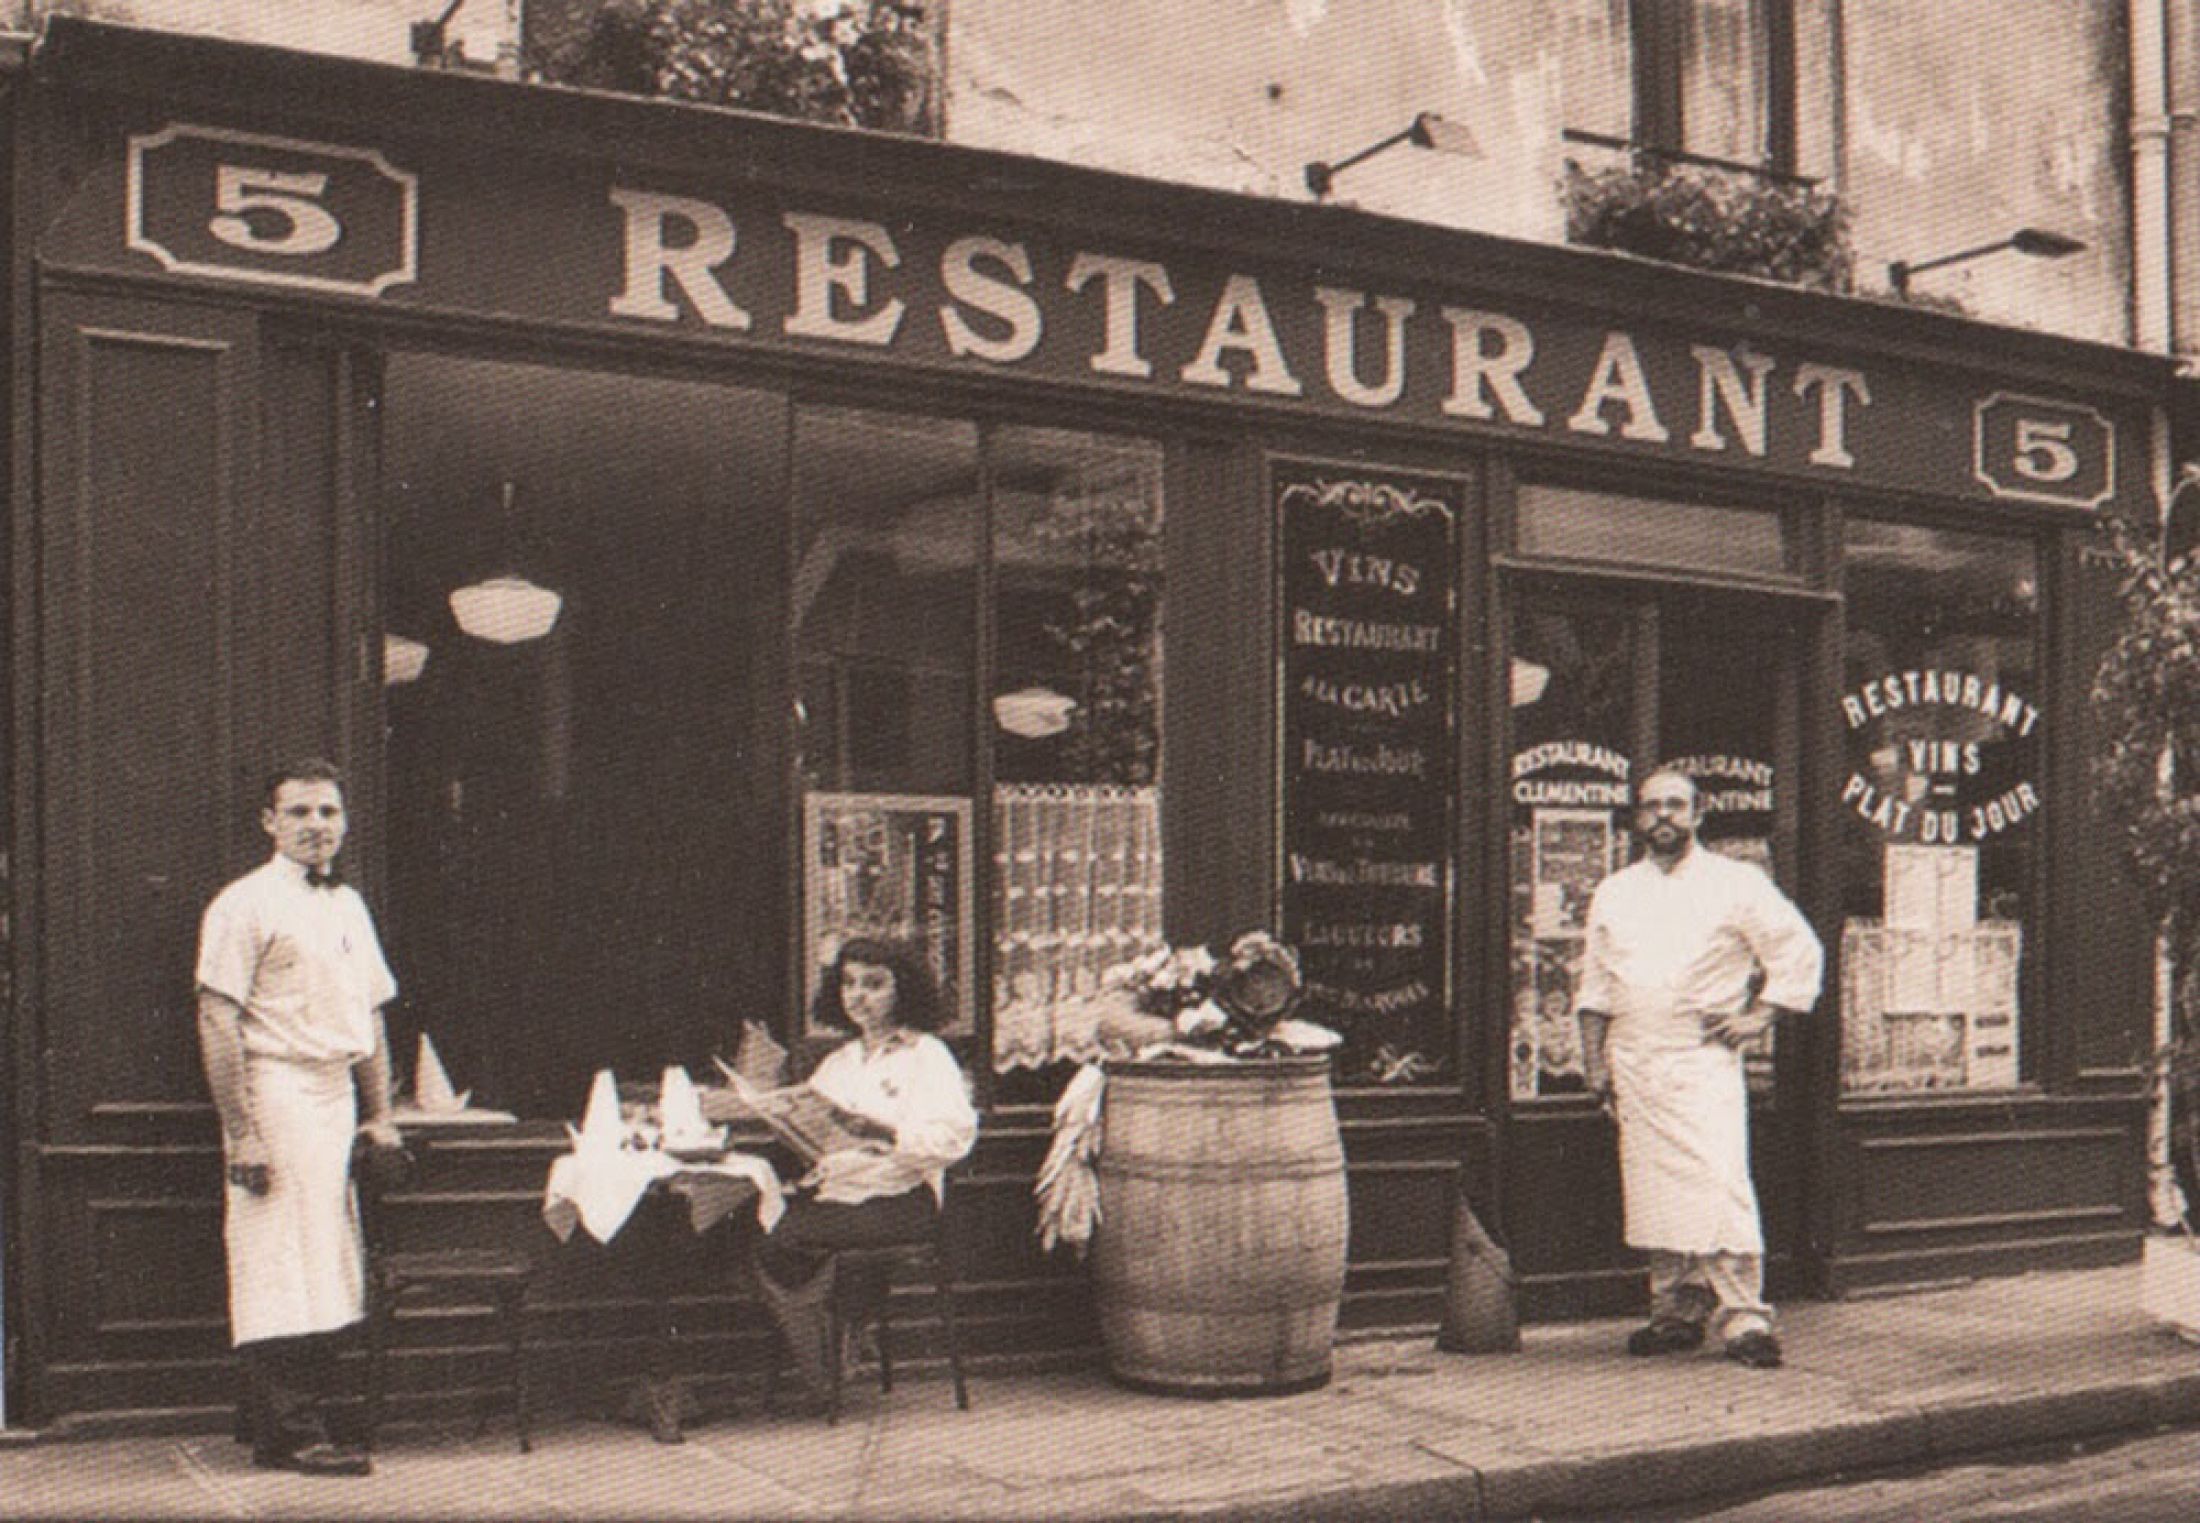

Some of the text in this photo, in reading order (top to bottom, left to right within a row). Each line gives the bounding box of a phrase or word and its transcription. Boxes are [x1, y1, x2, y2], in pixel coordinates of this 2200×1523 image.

[208, 165, 341, 253] 5
[608, 186, 1872, 470] RESTAURANT
[2013, 420, 2078, 481] 5
[1310, 549, 1420, 595] VINS
[1294, 608, 1440, 650] RESTAURANT
[1342, 680, 1430, 717] CARTE
[1841, 669, 2039, 737] RESTAURANT
[1511, 741, 1630, 780] RESTAURANT
[1666, 755, 1774, 786] TAURANT
[1908, 738, 1981, 775] VINS
[1512, 780, 1630, 804] CLEMENTINE
[1699, 788, 1773, 813] NTINE
[1841, 773, 2041, 843] PLAT DU JOUR
